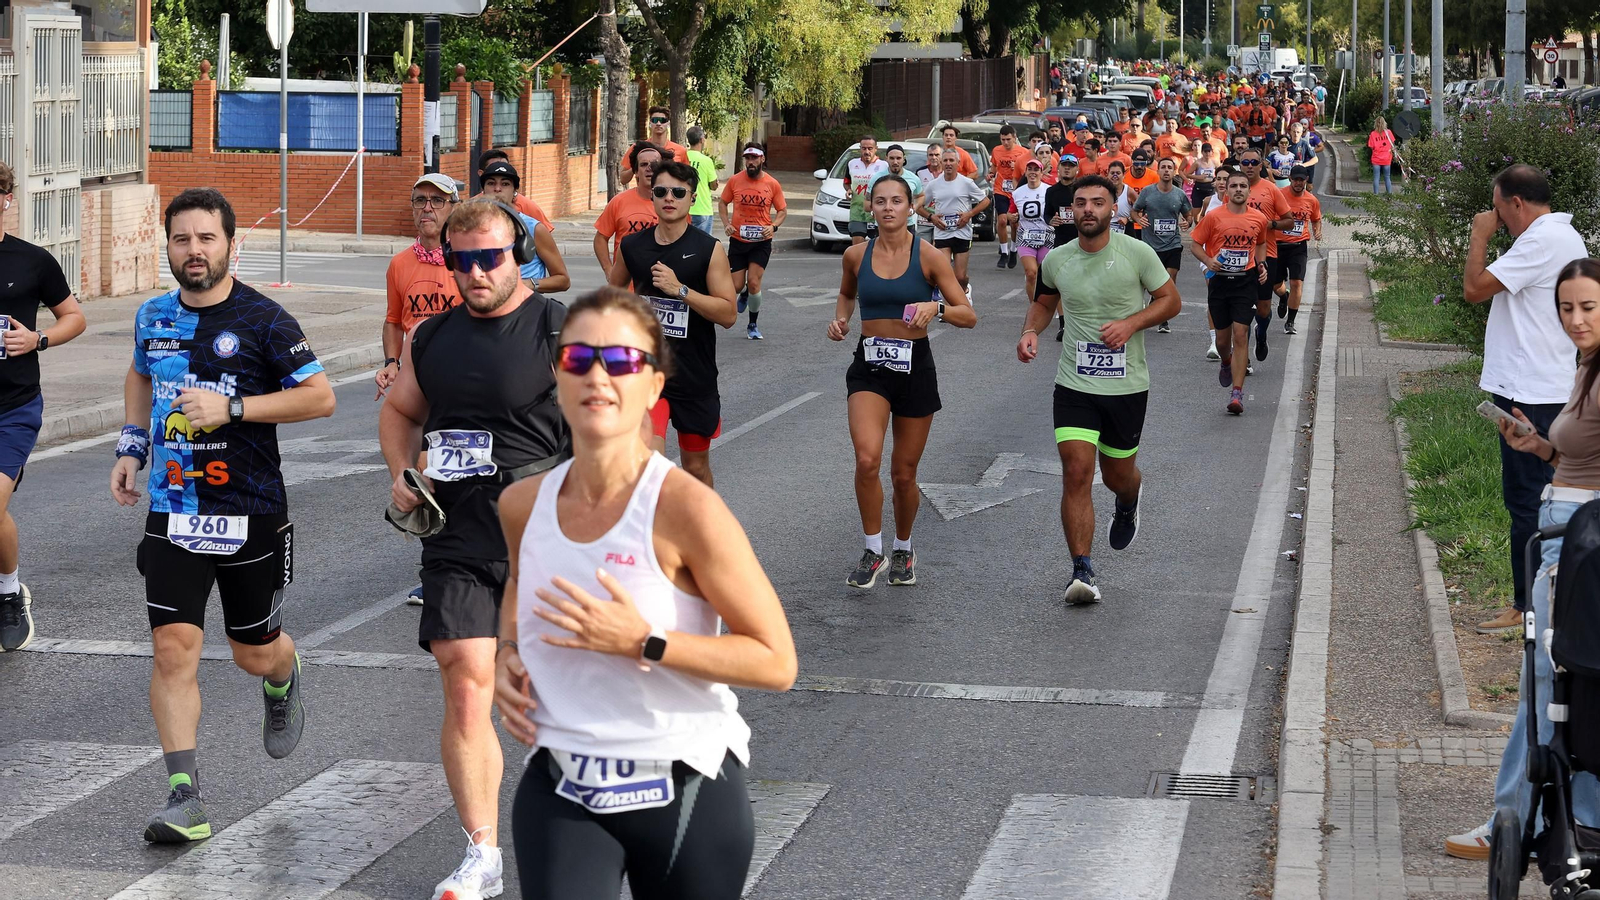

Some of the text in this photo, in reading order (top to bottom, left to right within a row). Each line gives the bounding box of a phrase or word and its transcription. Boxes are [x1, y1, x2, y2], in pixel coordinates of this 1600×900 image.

[1224, 235, 1254, 246] XXIX
[876, 347, 898, 360] 663
[1088, 354, 1114, 366] 723
[442, 449, 476, 468] 712
[188, 516, 228, 535] 960
[605, 553, 635, 566] FILA
